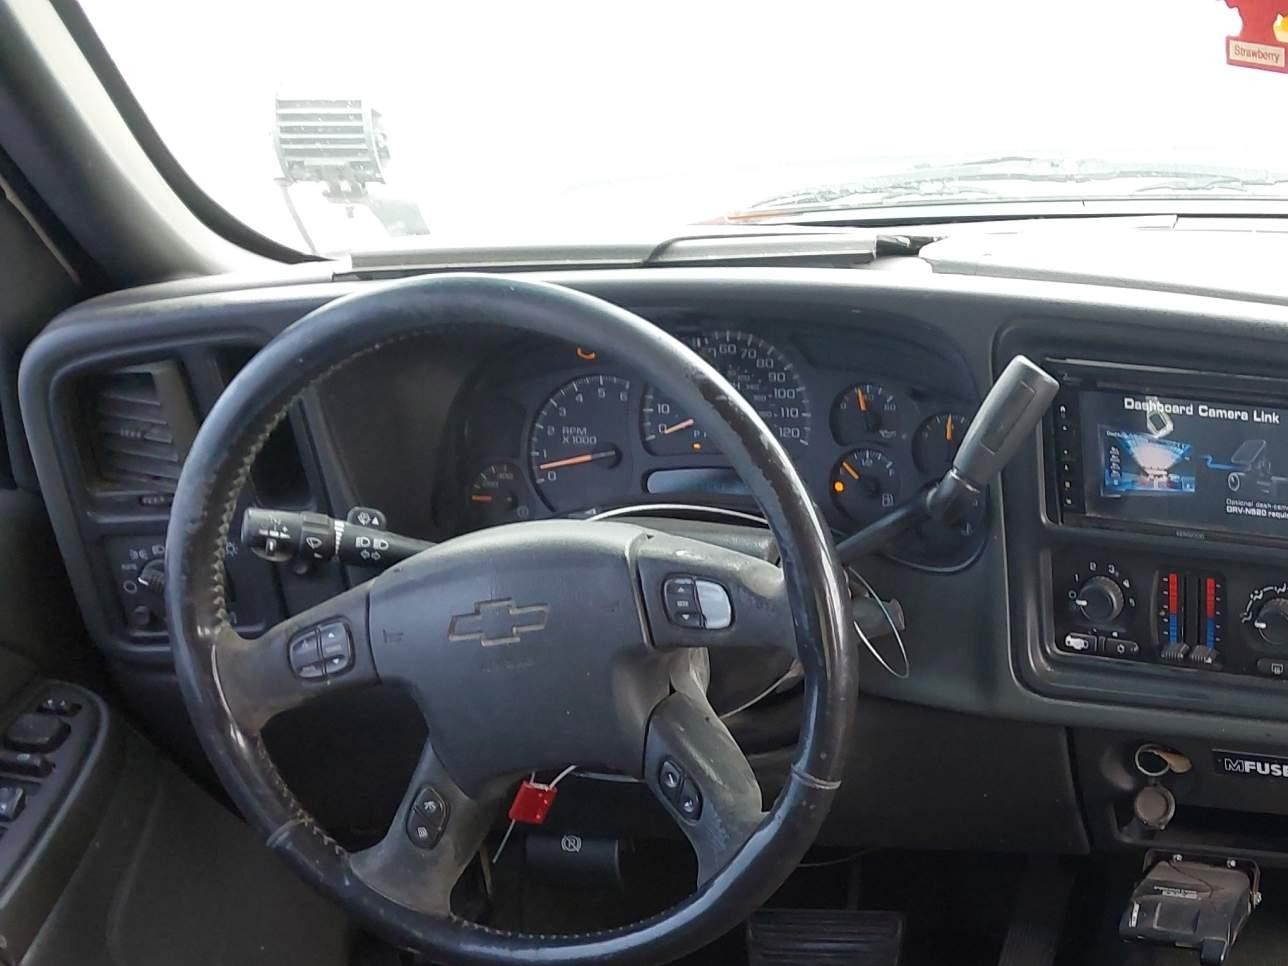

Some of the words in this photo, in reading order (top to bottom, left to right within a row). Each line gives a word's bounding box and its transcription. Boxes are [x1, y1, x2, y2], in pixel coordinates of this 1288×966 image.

[1233, 44, 1281, 64] Strawberry
[741, 348, 757, 360] 70
[773, 387, 796, 400] 100
[657, 403, 670, 415] 10
[780, 408, 799, 419] 110
[1123, 397, 1194, 415] Dashboard
[1198, 405, 1249, 421] Camera
[1253, 409, 1280, 424] Link
[561, 426, 588, 436] RPM
[779, 426, 800, 439] 120
[547, 471, 557, 482] 0
